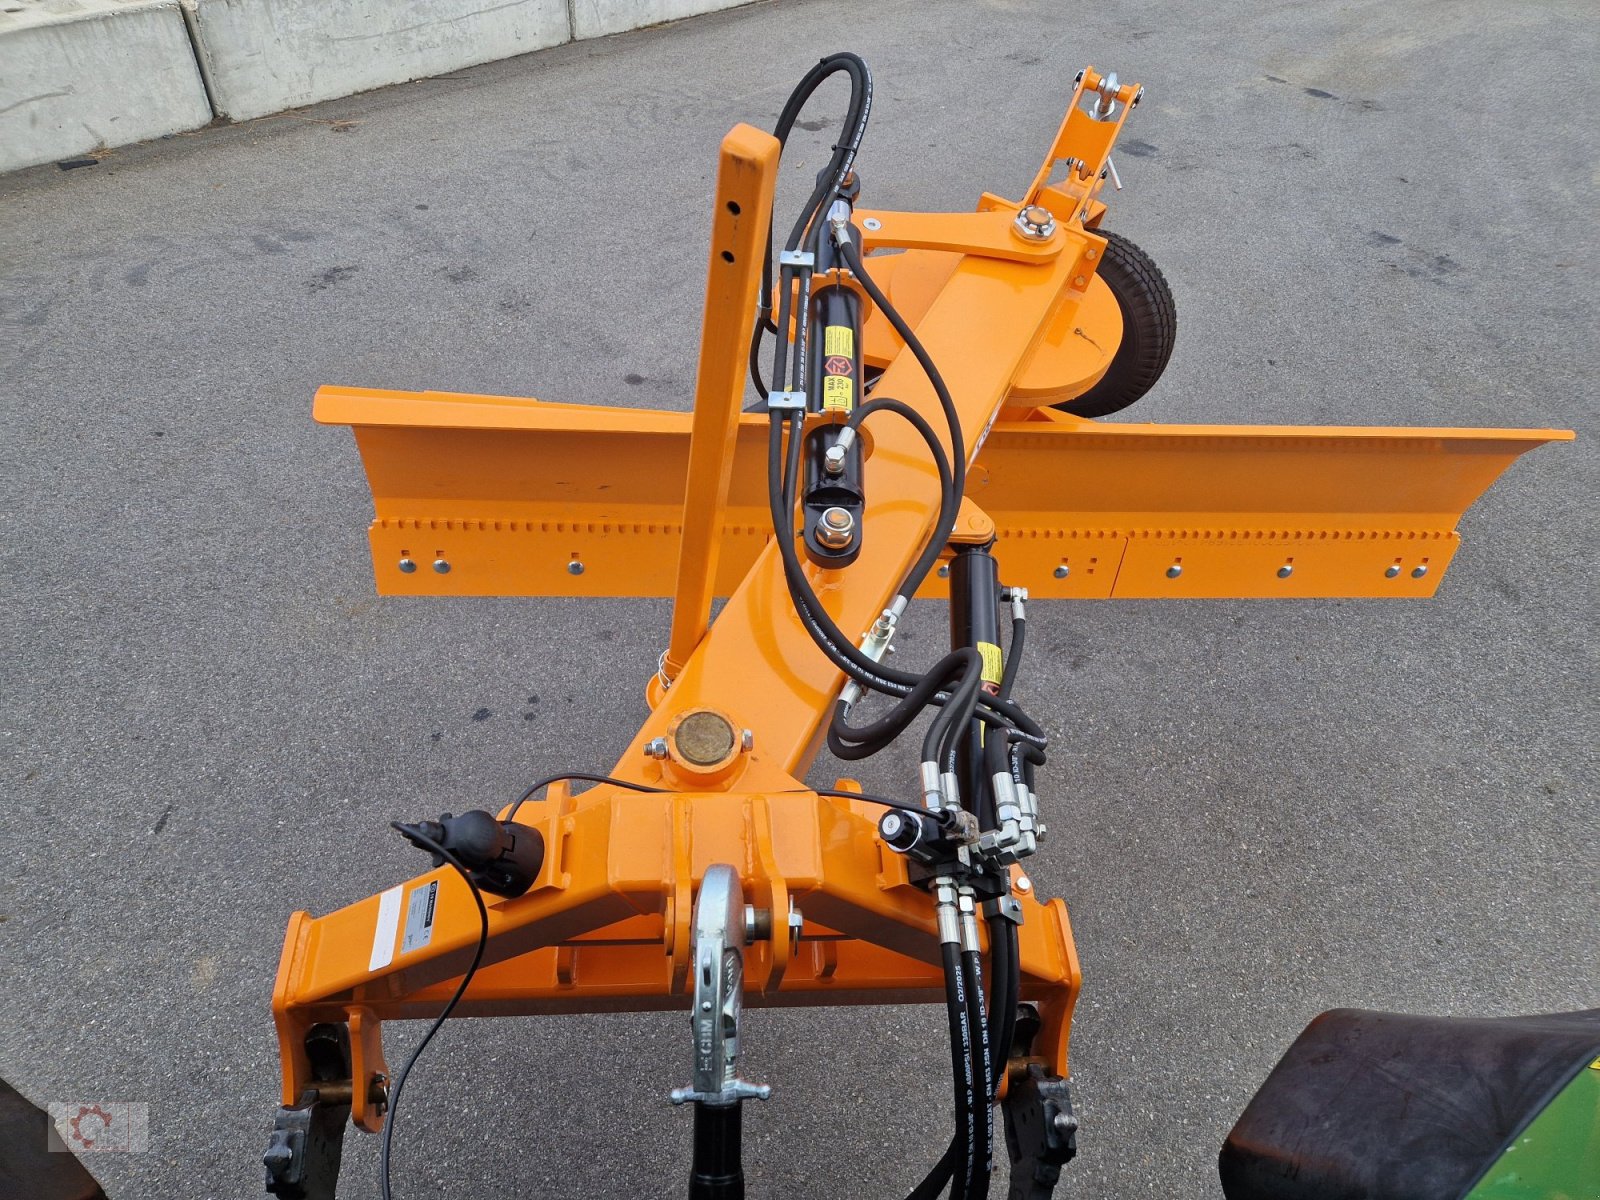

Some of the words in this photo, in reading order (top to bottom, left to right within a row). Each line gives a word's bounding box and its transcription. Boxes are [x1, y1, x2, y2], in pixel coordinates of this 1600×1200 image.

[828, 377, 836, 391] MAX
[960, 1011, 969, 1047] 330BAR
[981, 1017, 987, 1028] 10
[982, 1030, 989, 1044] DN
[985, 1083, 992, 1097] EN
